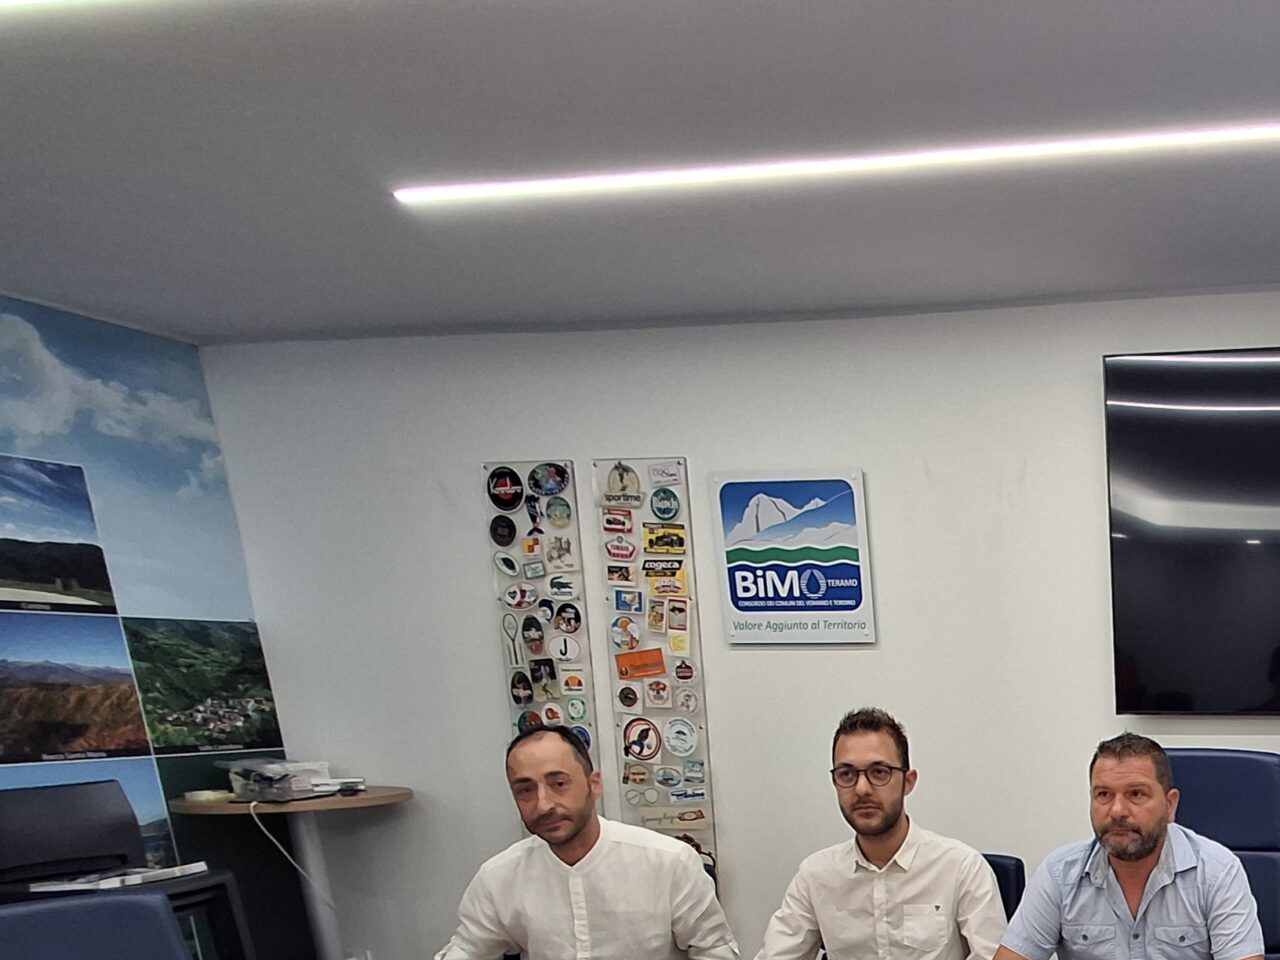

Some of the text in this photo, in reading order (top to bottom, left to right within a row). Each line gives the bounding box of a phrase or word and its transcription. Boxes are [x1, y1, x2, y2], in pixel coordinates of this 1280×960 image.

[827, 579, 858, 587] TERAMO
[733, 620, 867, 632] Valore Aggiunto al Territorio
